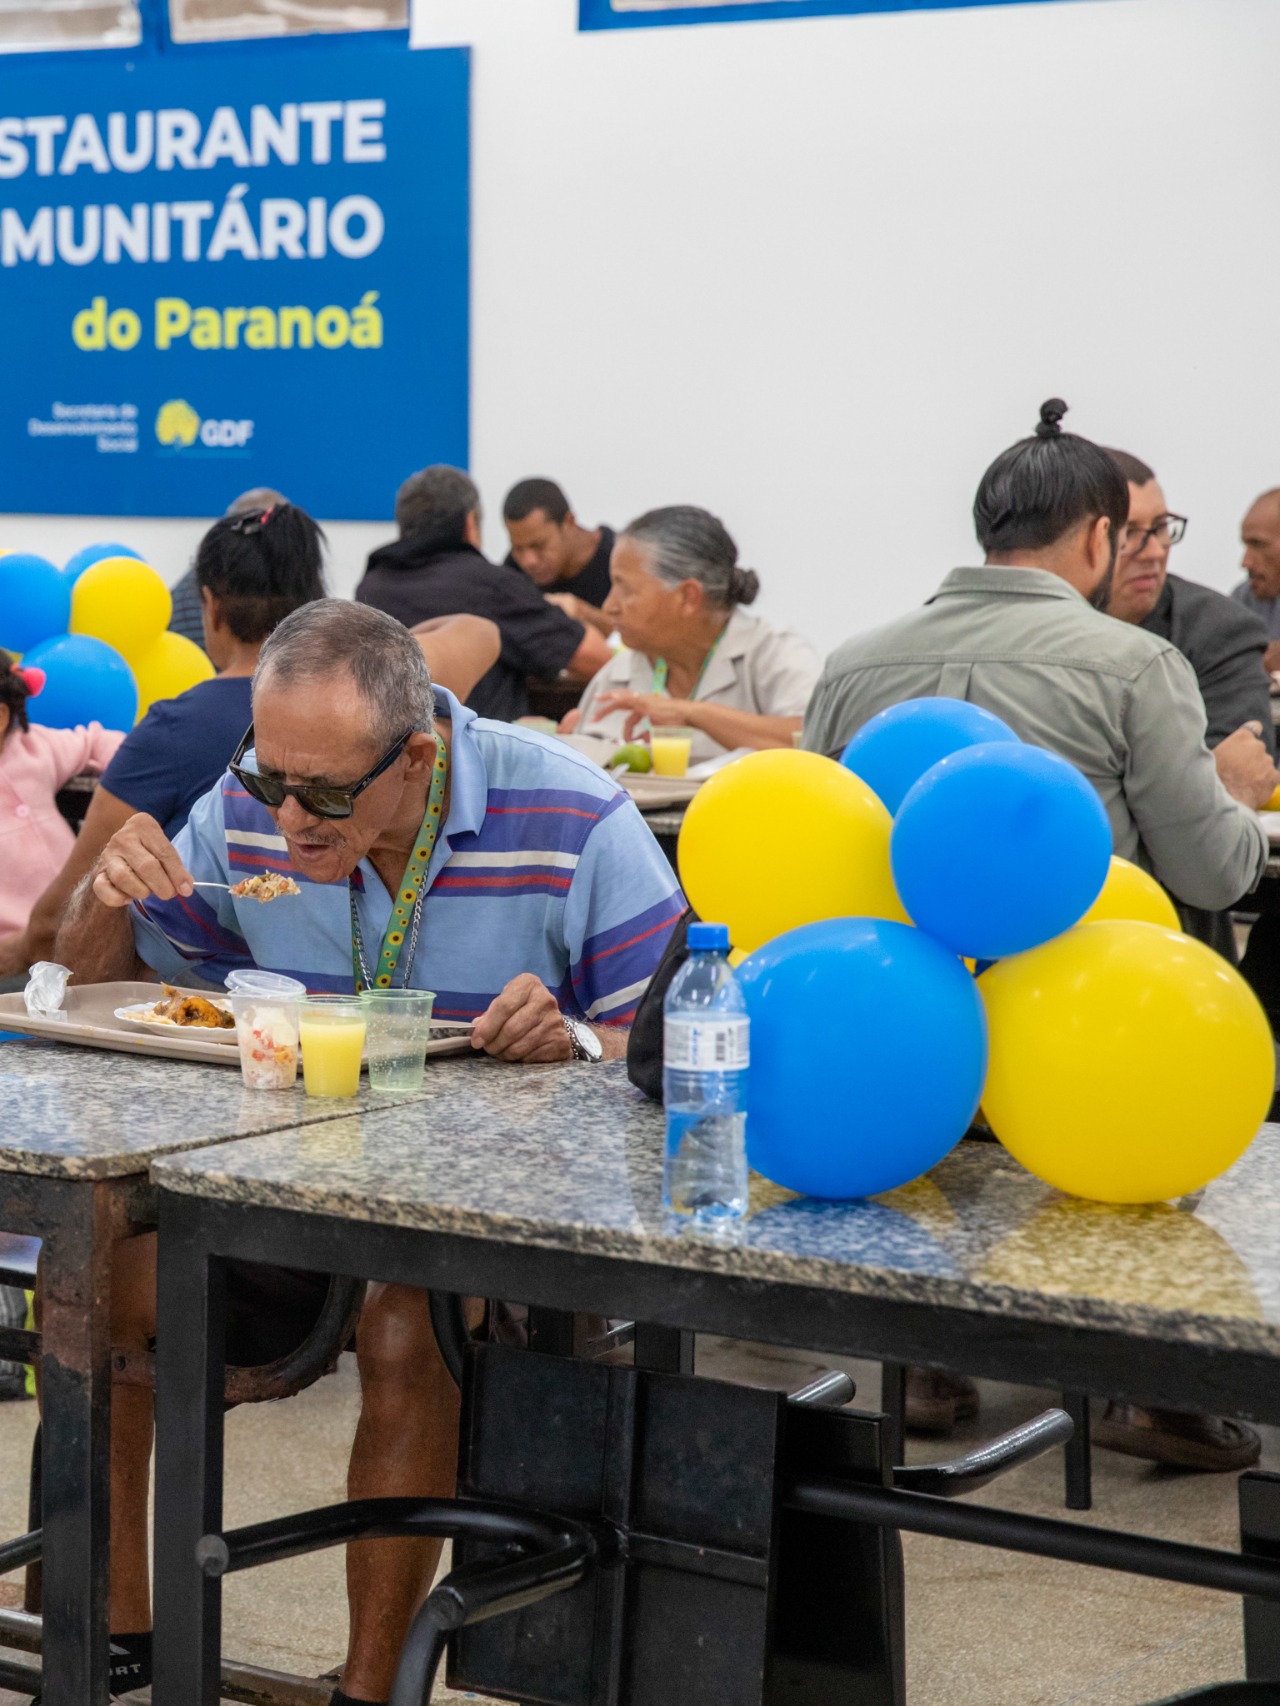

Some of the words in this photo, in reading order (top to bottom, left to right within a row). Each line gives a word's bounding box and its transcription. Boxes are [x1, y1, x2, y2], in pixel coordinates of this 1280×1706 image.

[72, 297, 141, 351] do
[156, 291, 382, 350] Paranoá
[201, 419, 254, 447] GDF
